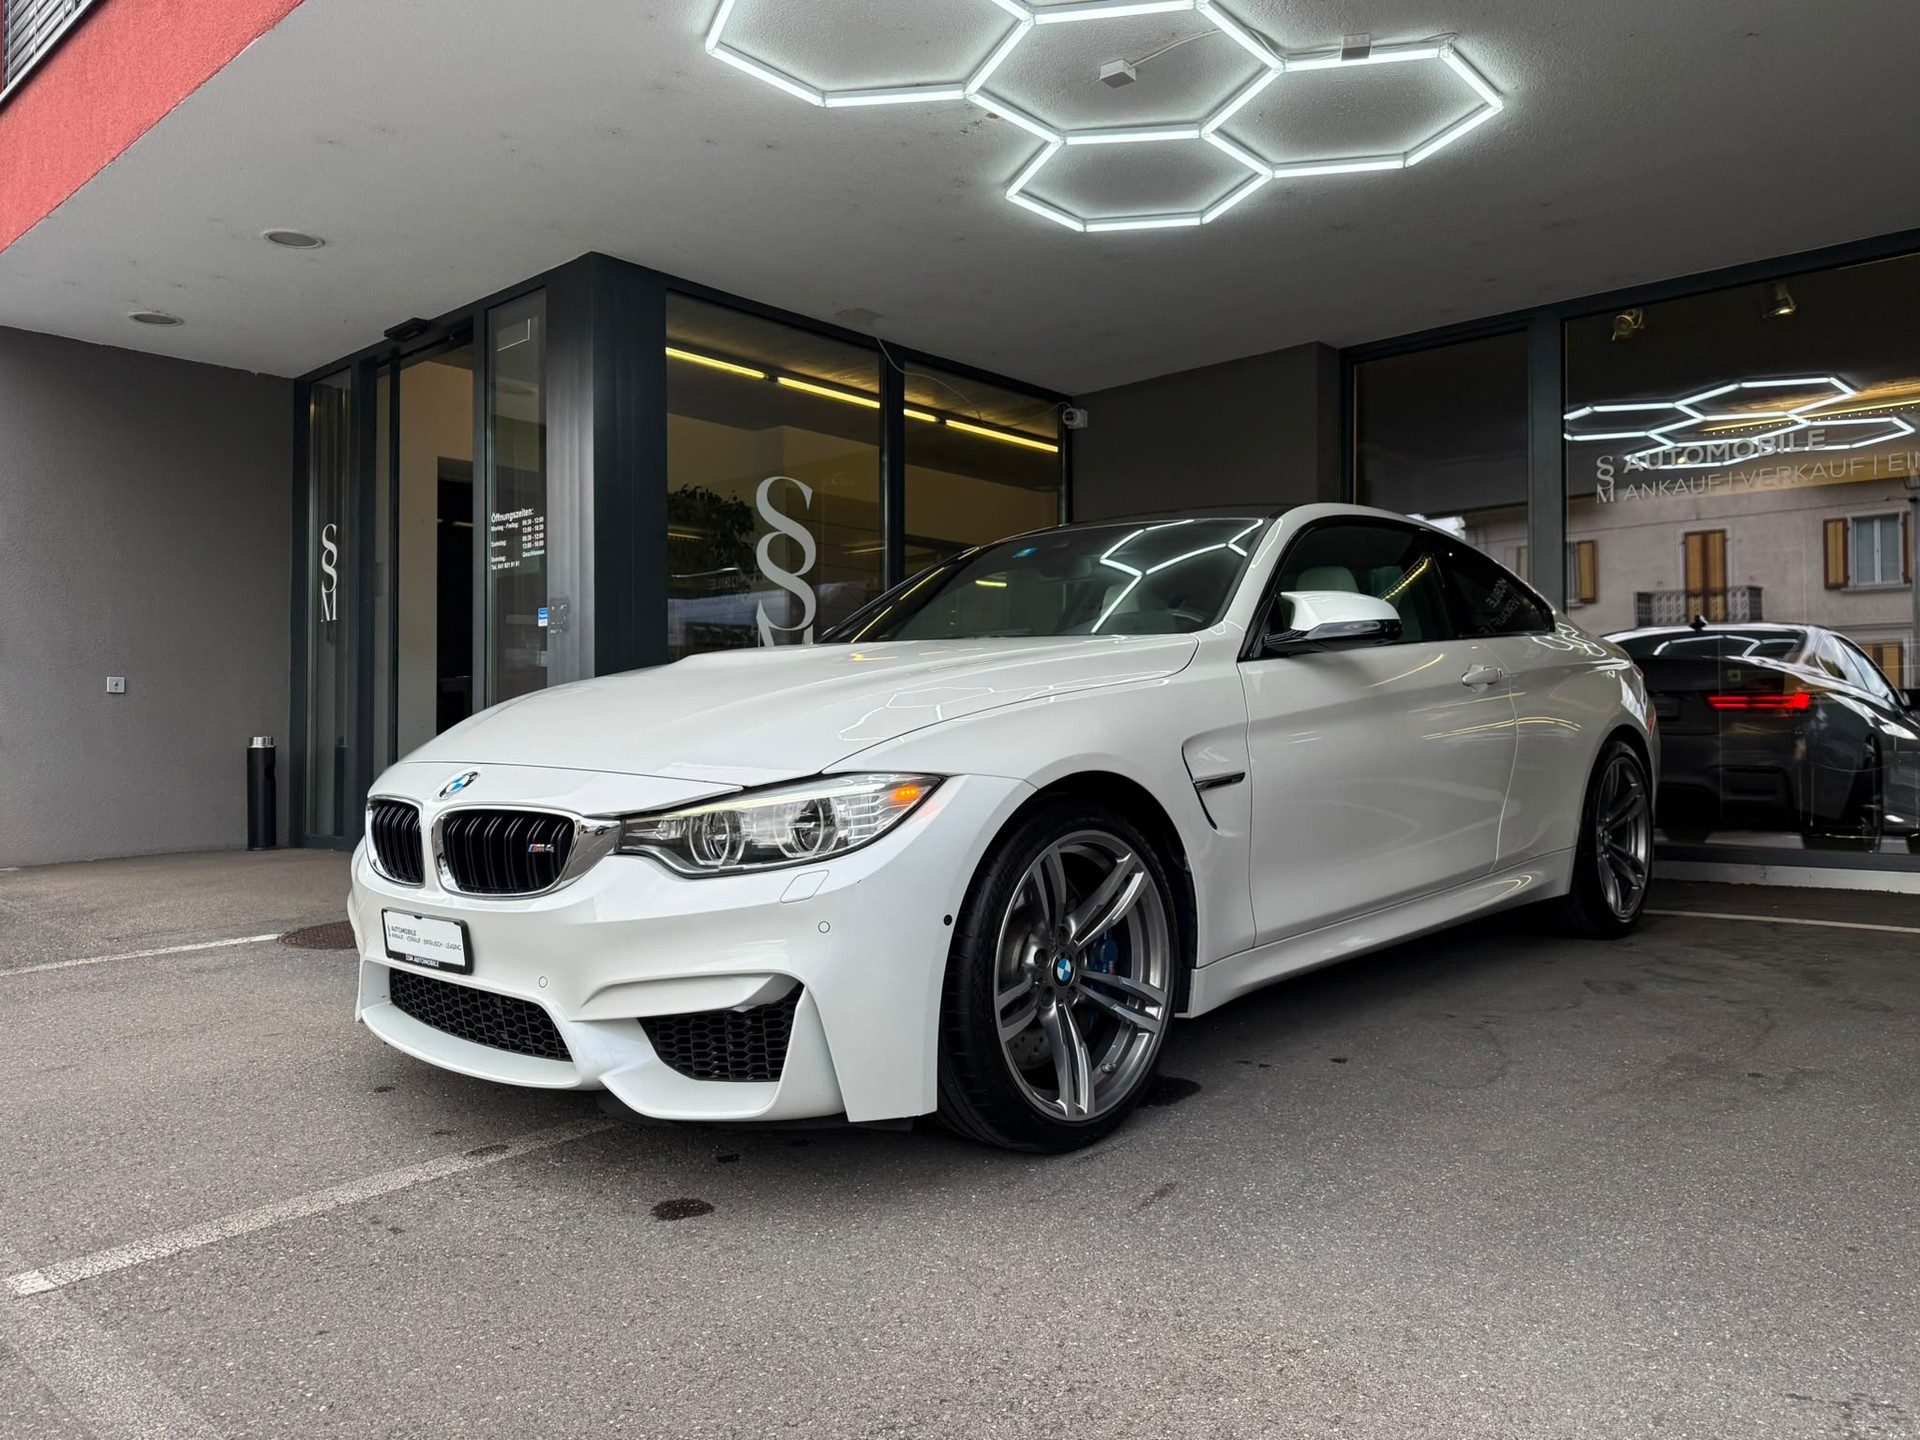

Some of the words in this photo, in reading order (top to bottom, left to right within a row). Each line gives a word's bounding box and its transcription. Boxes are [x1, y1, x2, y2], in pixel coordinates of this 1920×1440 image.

[1622, 428, 1826, 474] AUTOMOBILE
[1624, 473, 1722, 501] ANKAUF
[1739, 457, 1865, 487] VERKAUF
[491, 508, 534, 523] Öffnungszeiten:
[528, 844, 554, 853] M4
[391, 925, 417, 936] AUTOMOBILE
[414, 956, 439, 967] AUTOMOBILE
